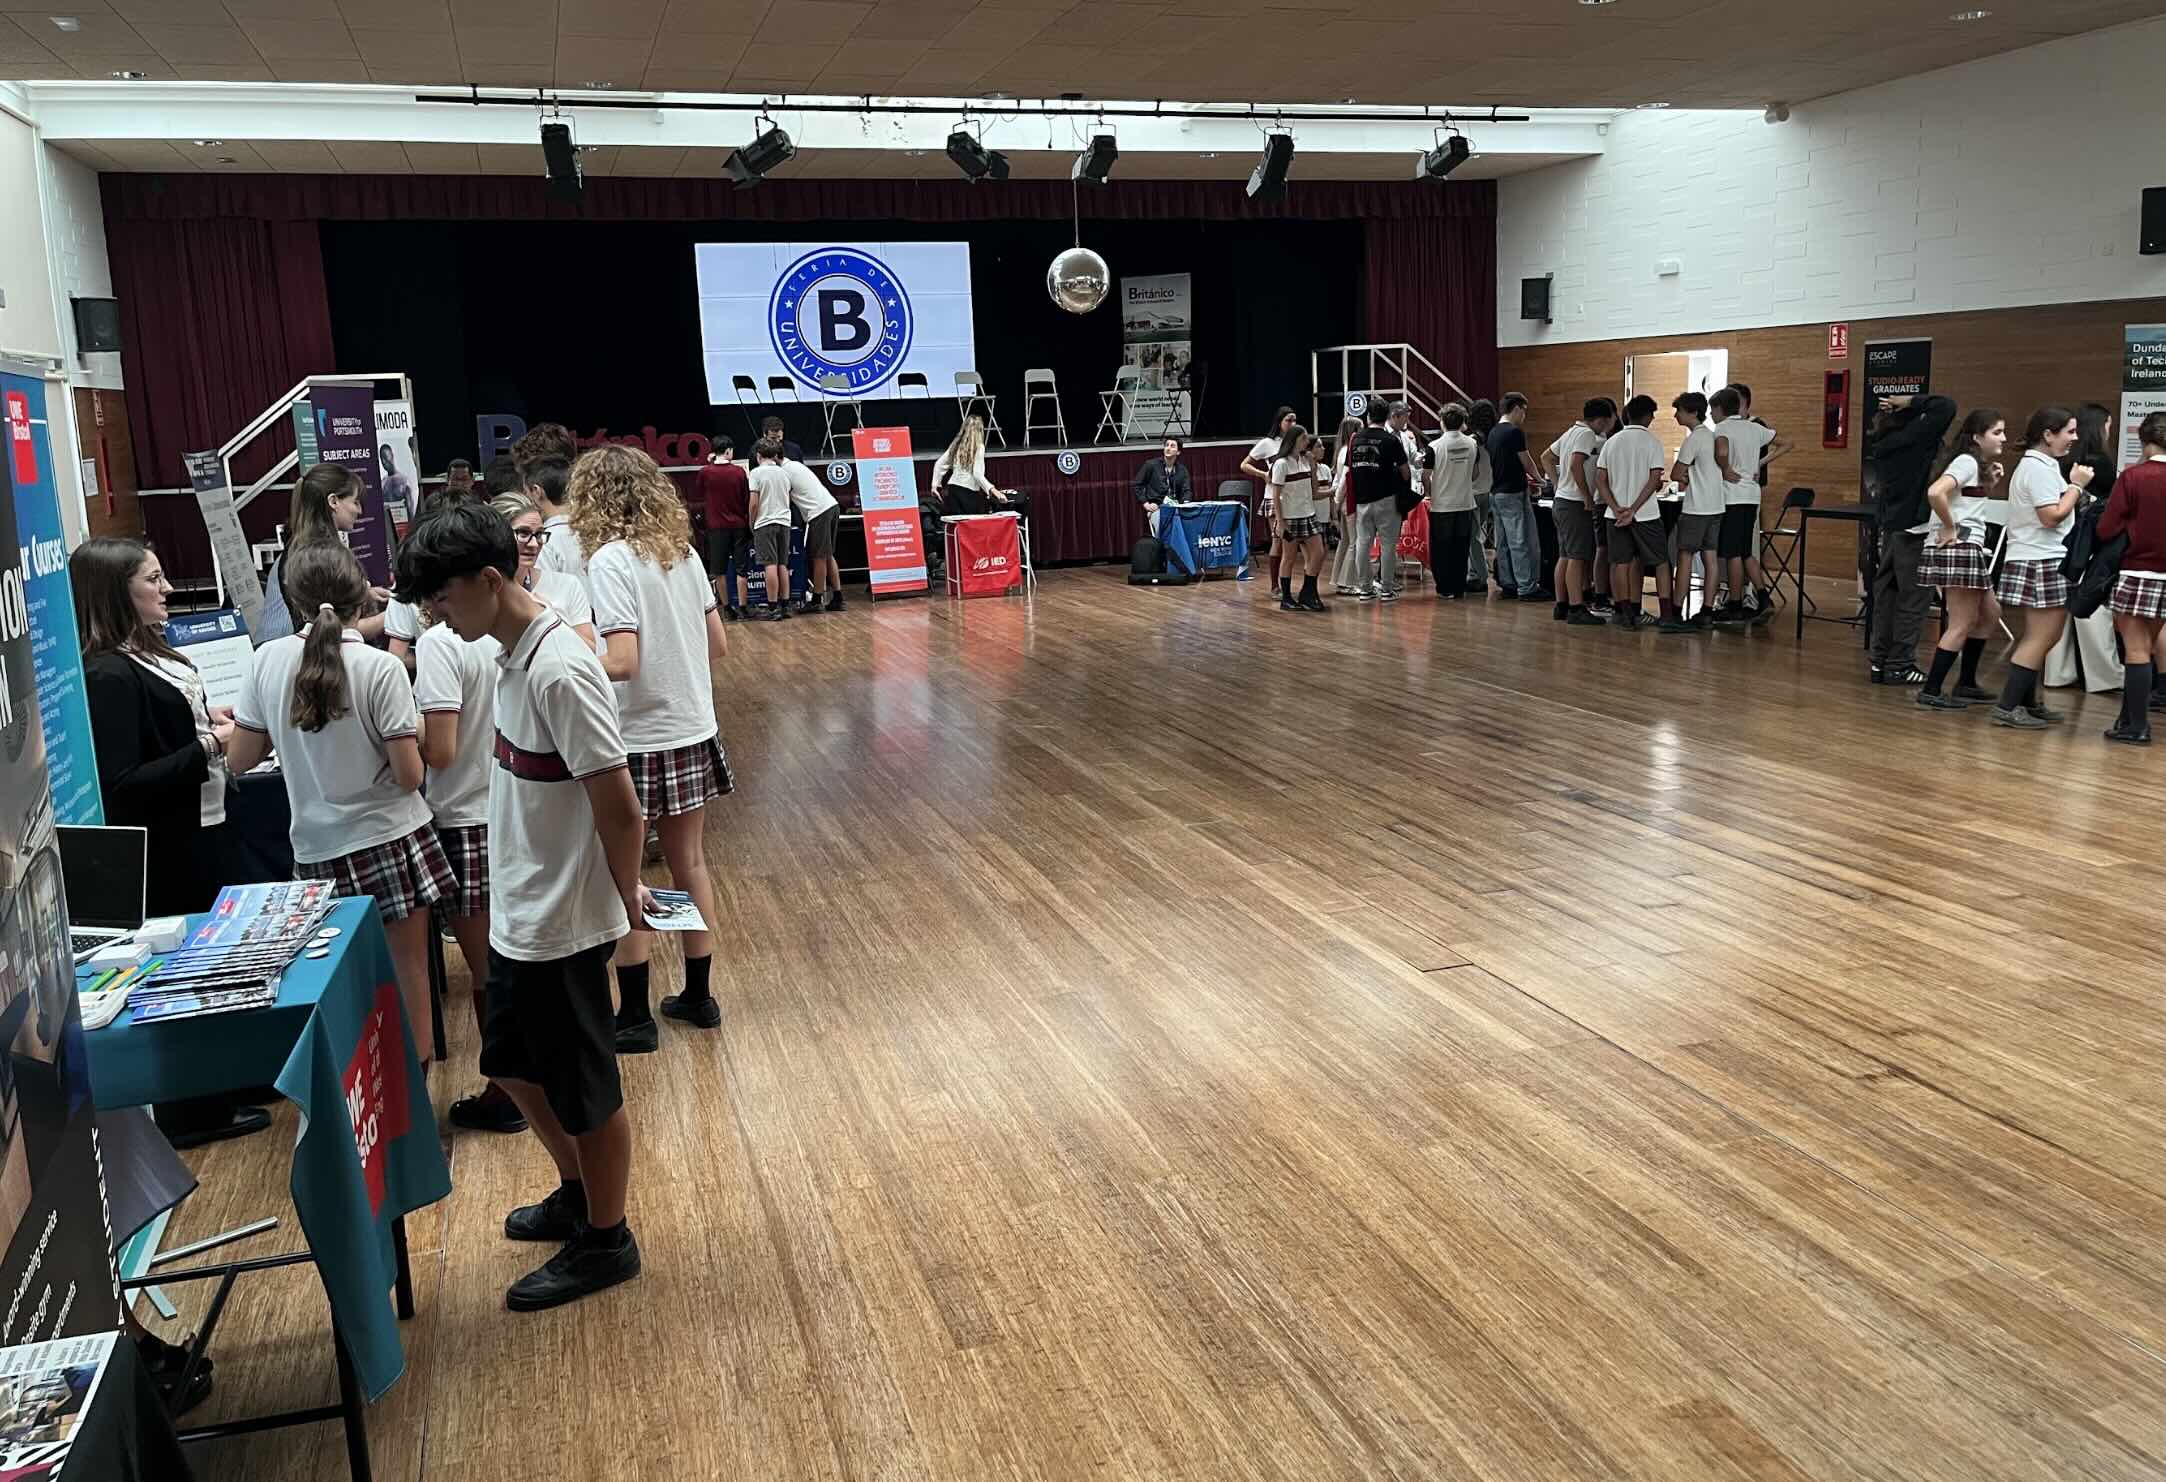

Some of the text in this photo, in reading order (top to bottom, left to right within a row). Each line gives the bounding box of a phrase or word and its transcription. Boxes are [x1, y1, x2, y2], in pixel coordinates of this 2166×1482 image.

[788, 258, 888, 292] FERIA DE
[1128, 287, 1175, 299] Británico
[817, 289, 872, 352] B
[780, 319, 899, 385] UNIVEIDADES
[2131, 356, 2143, 366] of
[1872, 384, 1921, 394] GRADUATES
[1353, 399, 1361, 408] B
[323, 448, 371, 461] SUBJECT AREAS
[1066, 456, 1074, 467] B
[835, 466, 845, 478] B
[32, 534, 64, 577] Courses
[991, 556, 1007, 567] IED
[39, 1209, 58, 1254] service
[38, 1282, 52, 1323] gym
